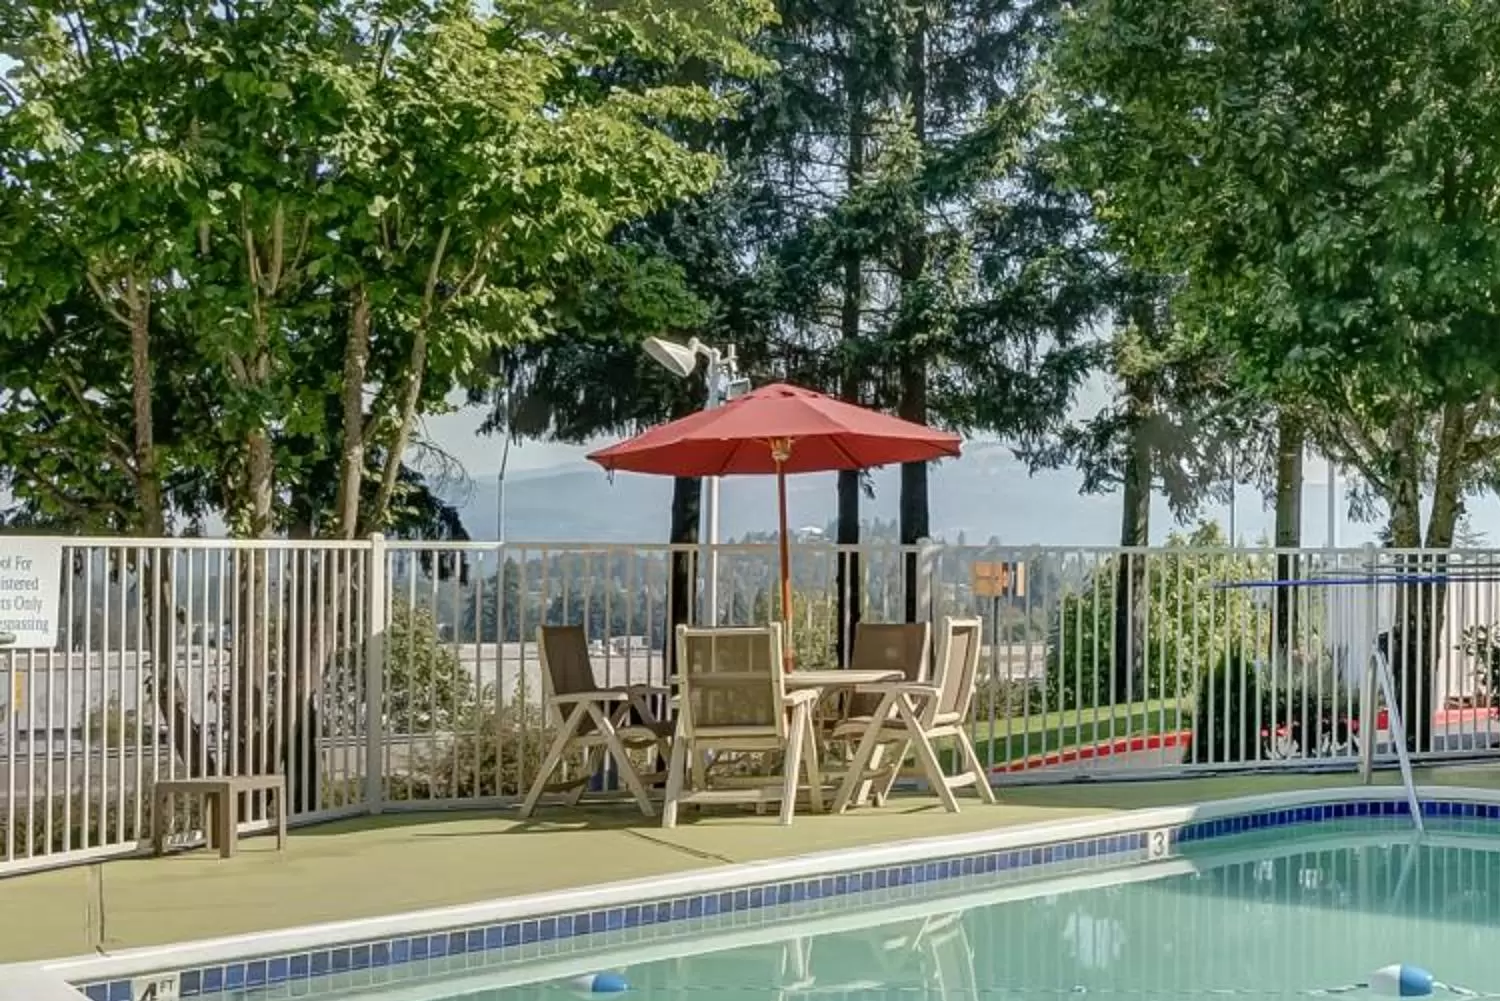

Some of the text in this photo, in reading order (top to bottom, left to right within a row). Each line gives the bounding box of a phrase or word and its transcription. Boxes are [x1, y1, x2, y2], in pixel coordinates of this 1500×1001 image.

[15, 555, 33, 571] For
[14, 595, 42, 614] Only
[1153, 831, 1165, 856] 3
